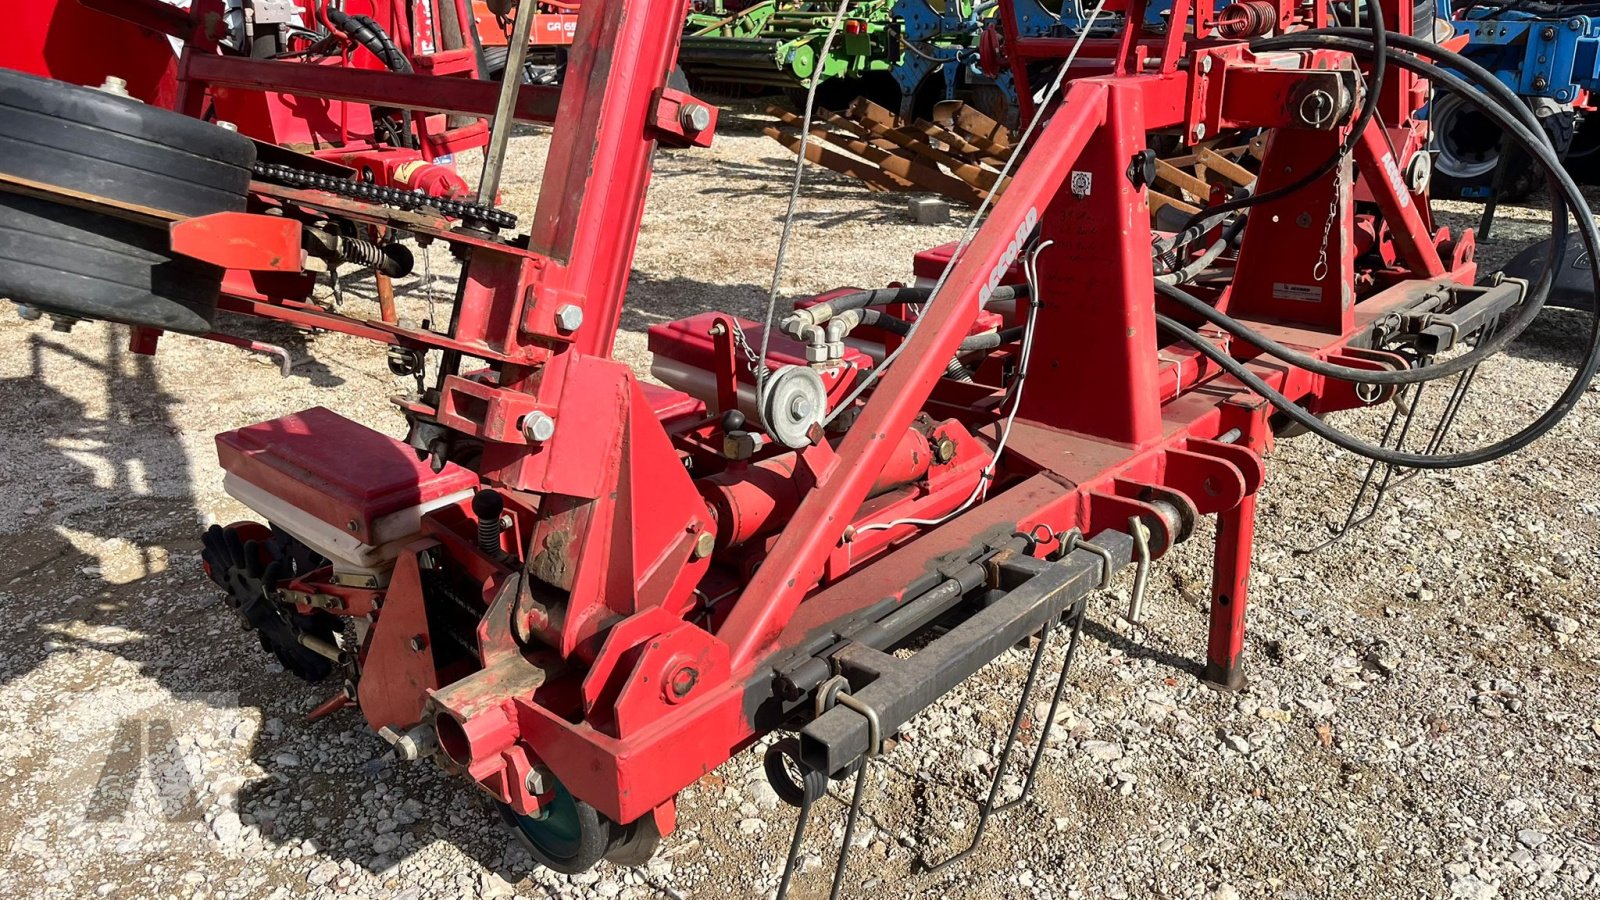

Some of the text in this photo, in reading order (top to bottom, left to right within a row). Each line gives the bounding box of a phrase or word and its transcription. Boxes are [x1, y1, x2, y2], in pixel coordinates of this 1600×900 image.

[547, 22, 561, 31] GA
[1381, 151, 1410, 208] ACCORD
[979, 206, 1037, 312] ACCORD
